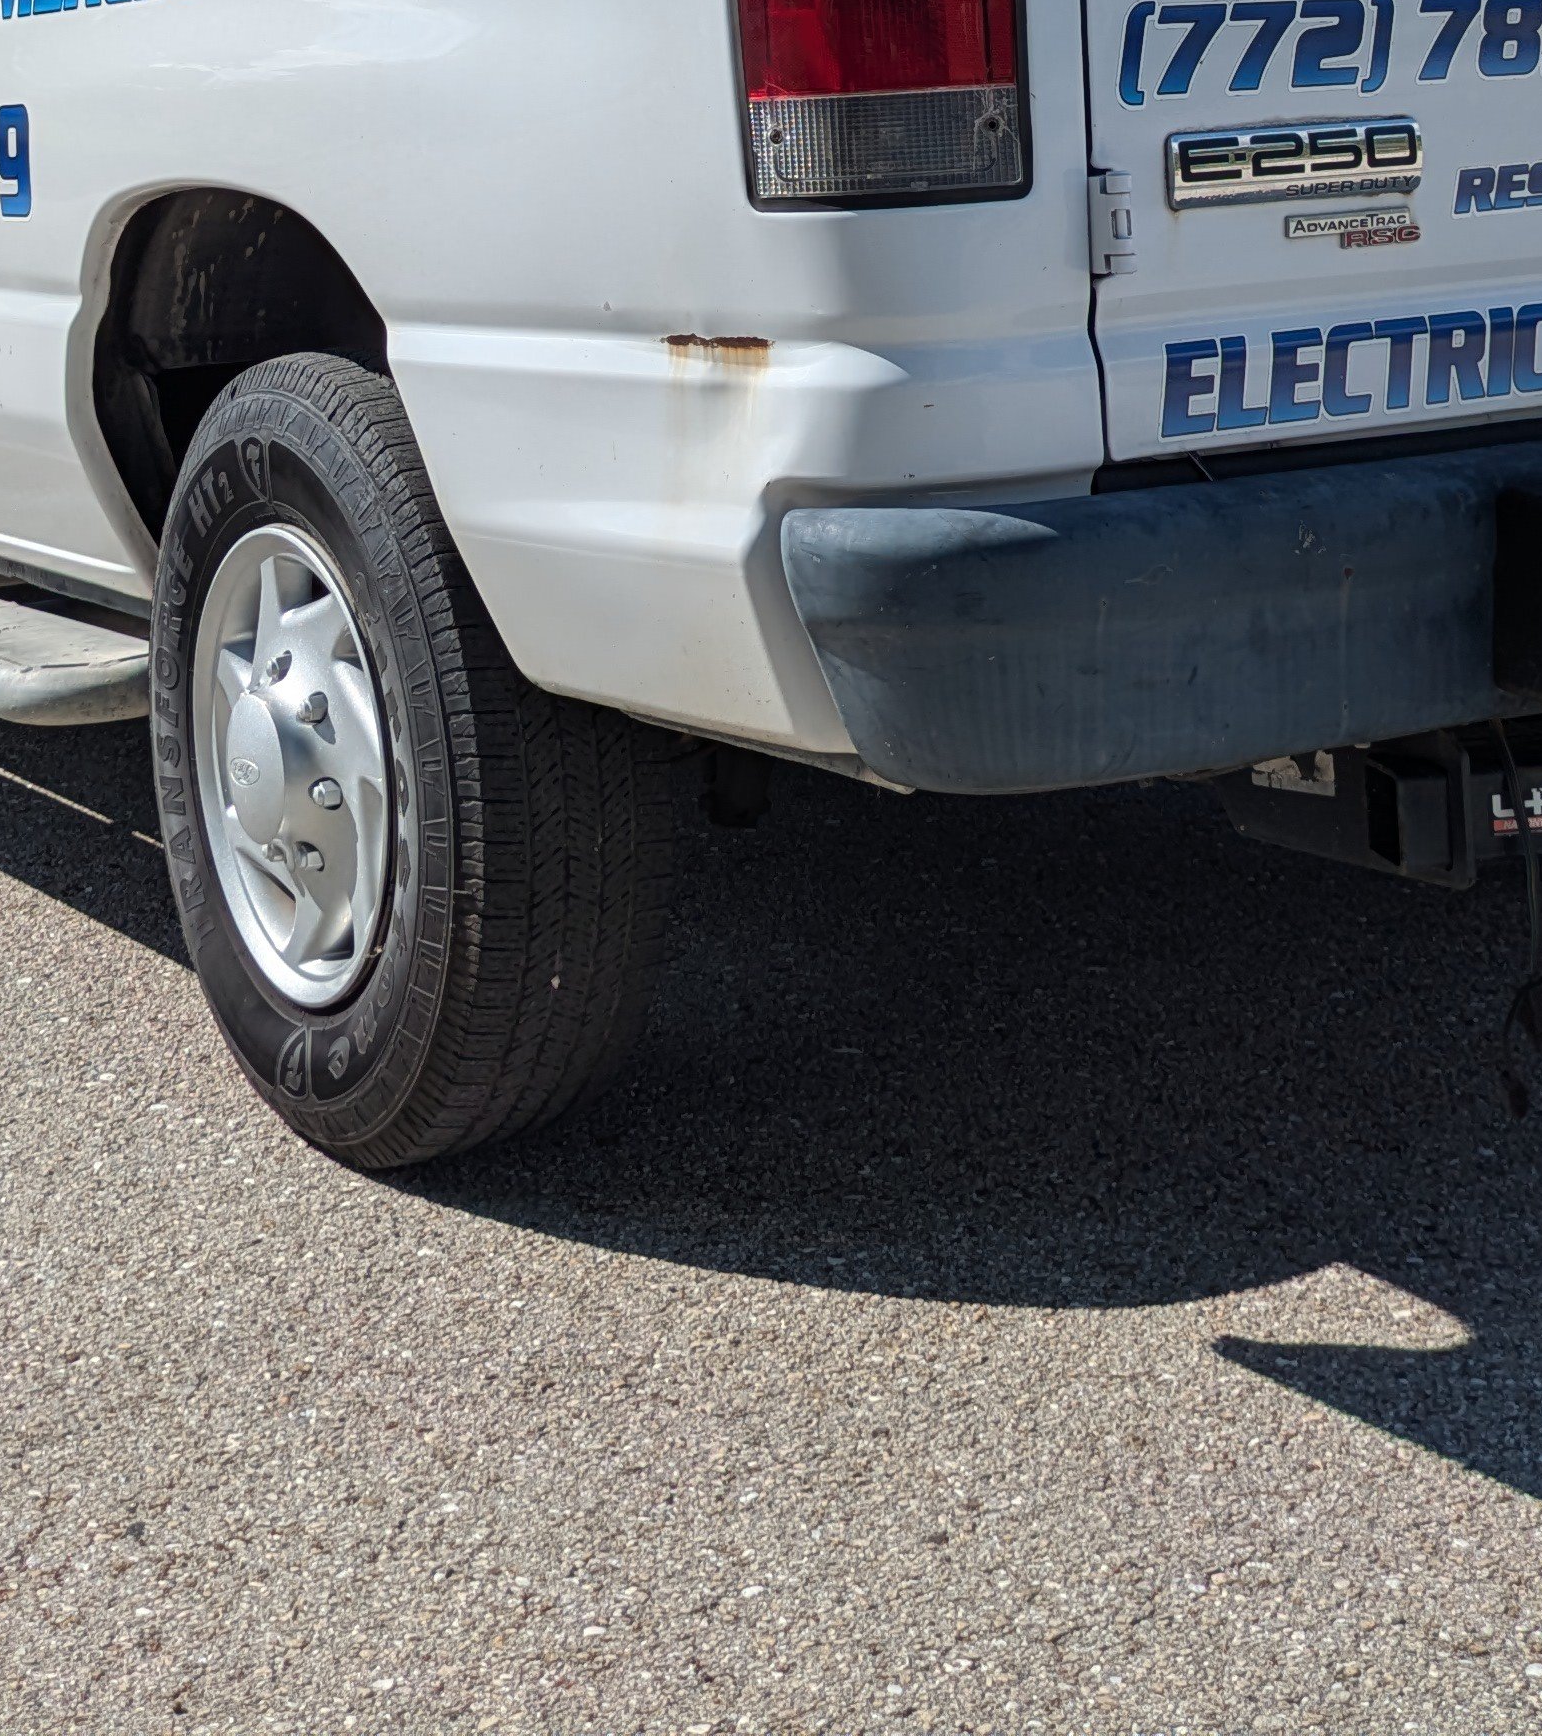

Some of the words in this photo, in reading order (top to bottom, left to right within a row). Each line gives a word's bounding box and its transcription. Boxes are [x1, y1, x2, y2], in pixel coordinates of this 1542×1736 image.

[1178, 124, 1418, 183] E-250
[1285, 181, 1354, 198] SUPER
[1359, 174, 1416, 191] DUTY
[1343, 223, 1422, 248] RSC
